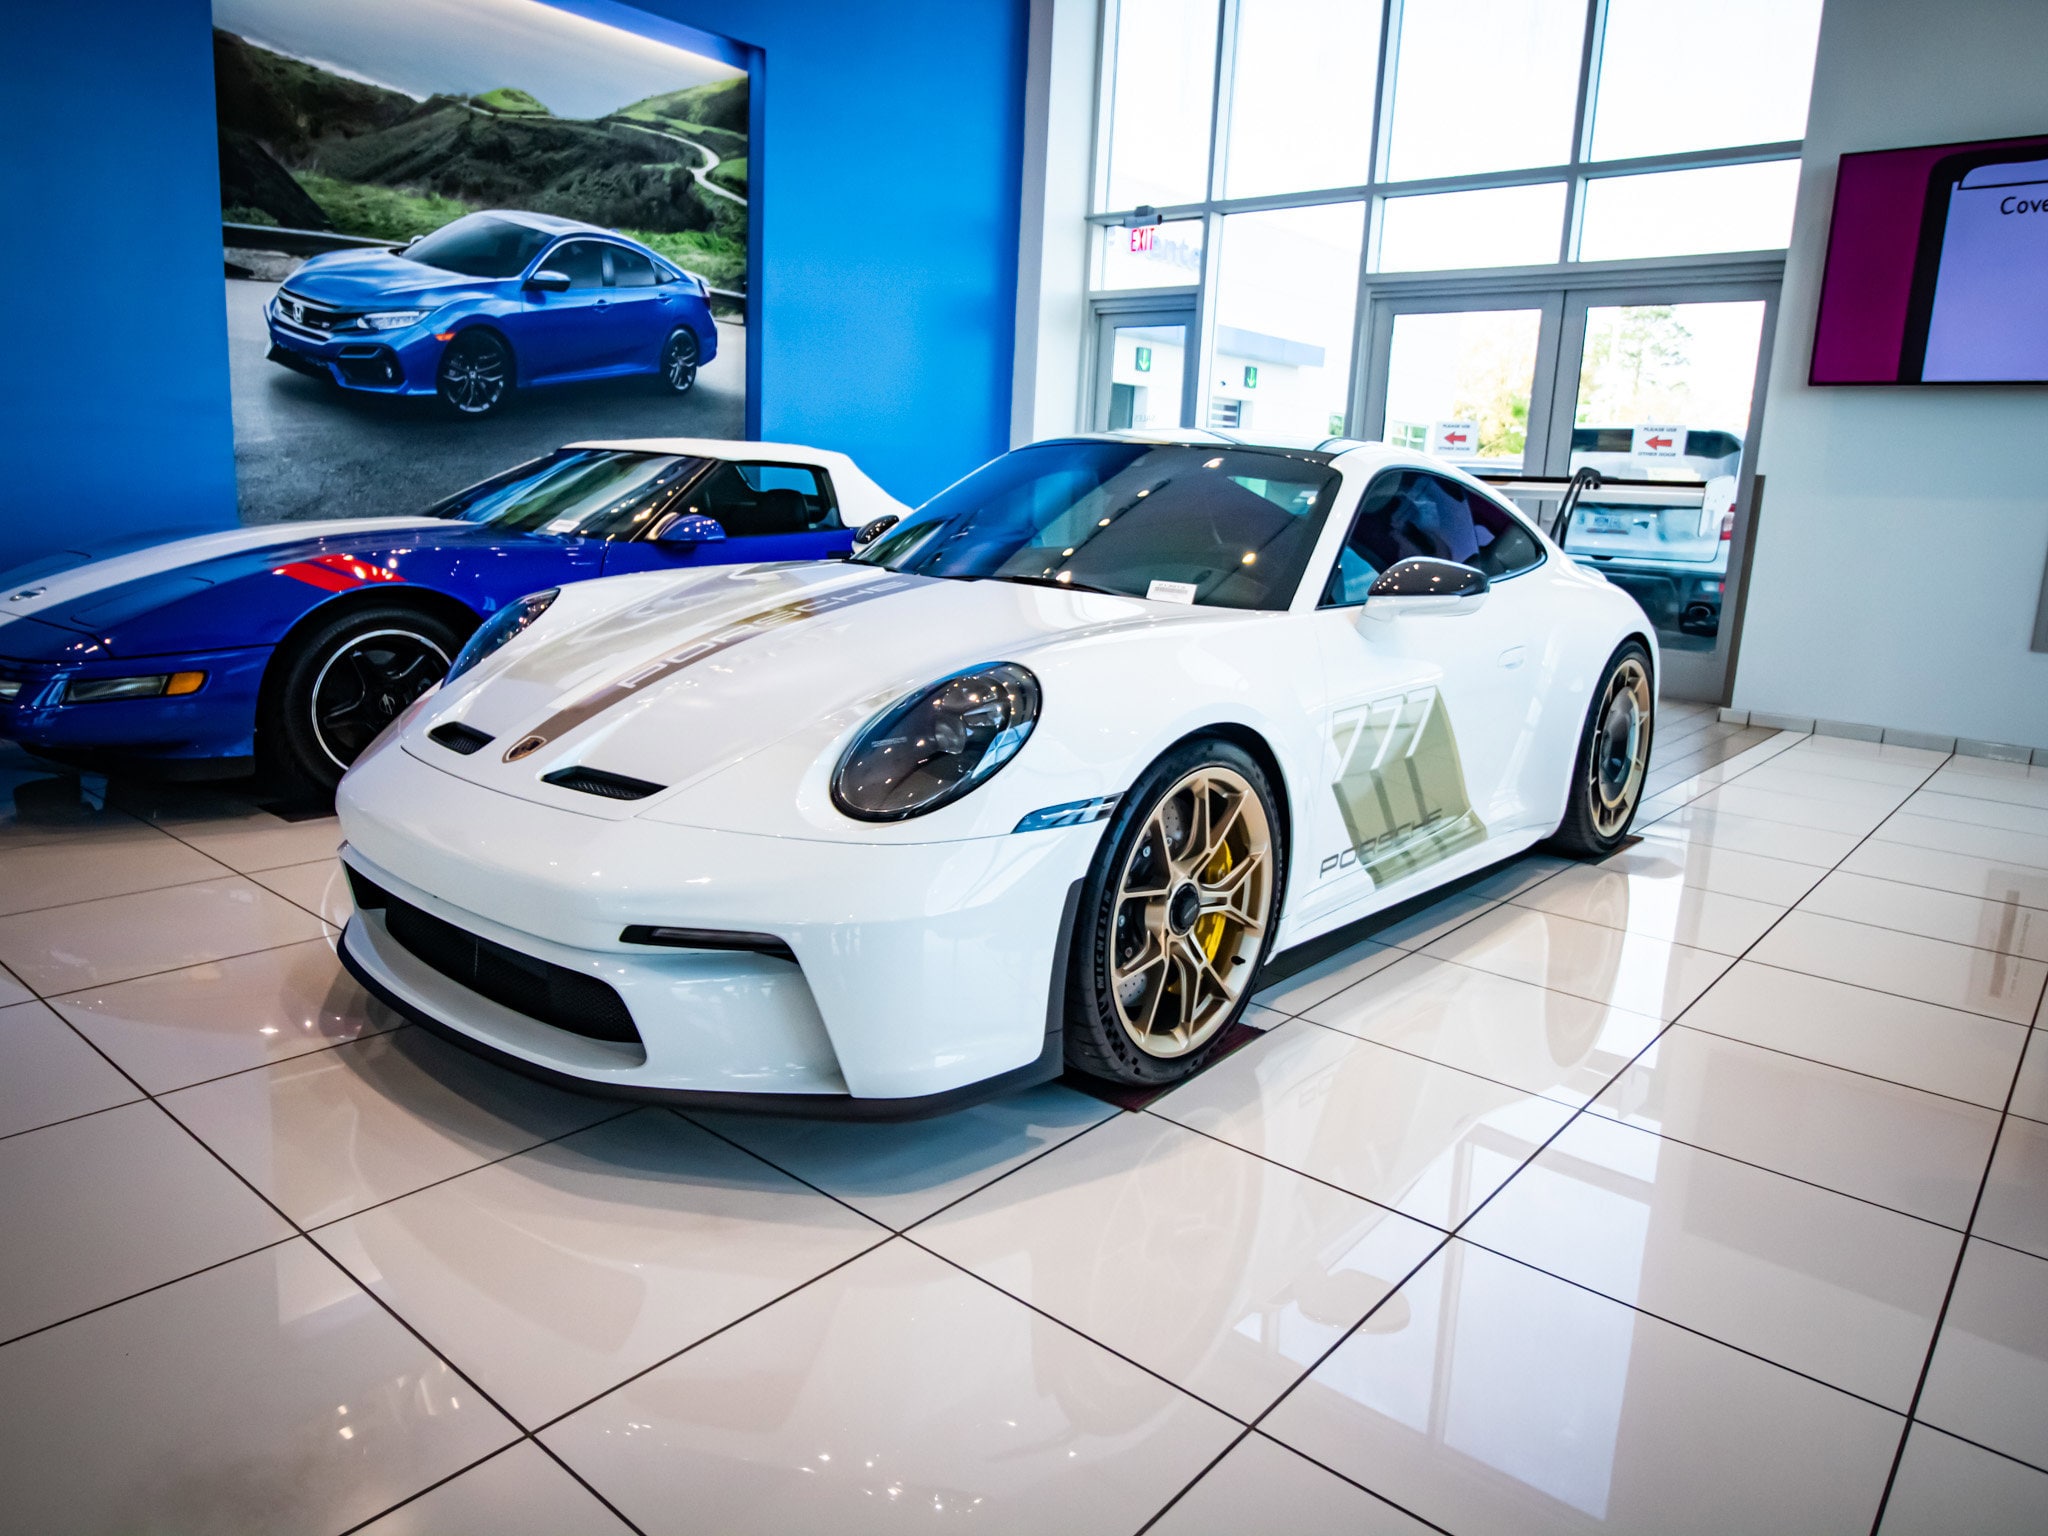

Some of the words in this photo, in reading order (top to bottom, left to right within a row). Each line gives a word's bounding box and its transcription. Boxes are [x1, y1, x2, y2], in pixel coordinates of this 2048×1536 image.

[1130, 227, 1155, 251] EXIT
[617, 581, 910, 689] PORSCHE
[1095, 890, 1111, 989] MICHELIN
